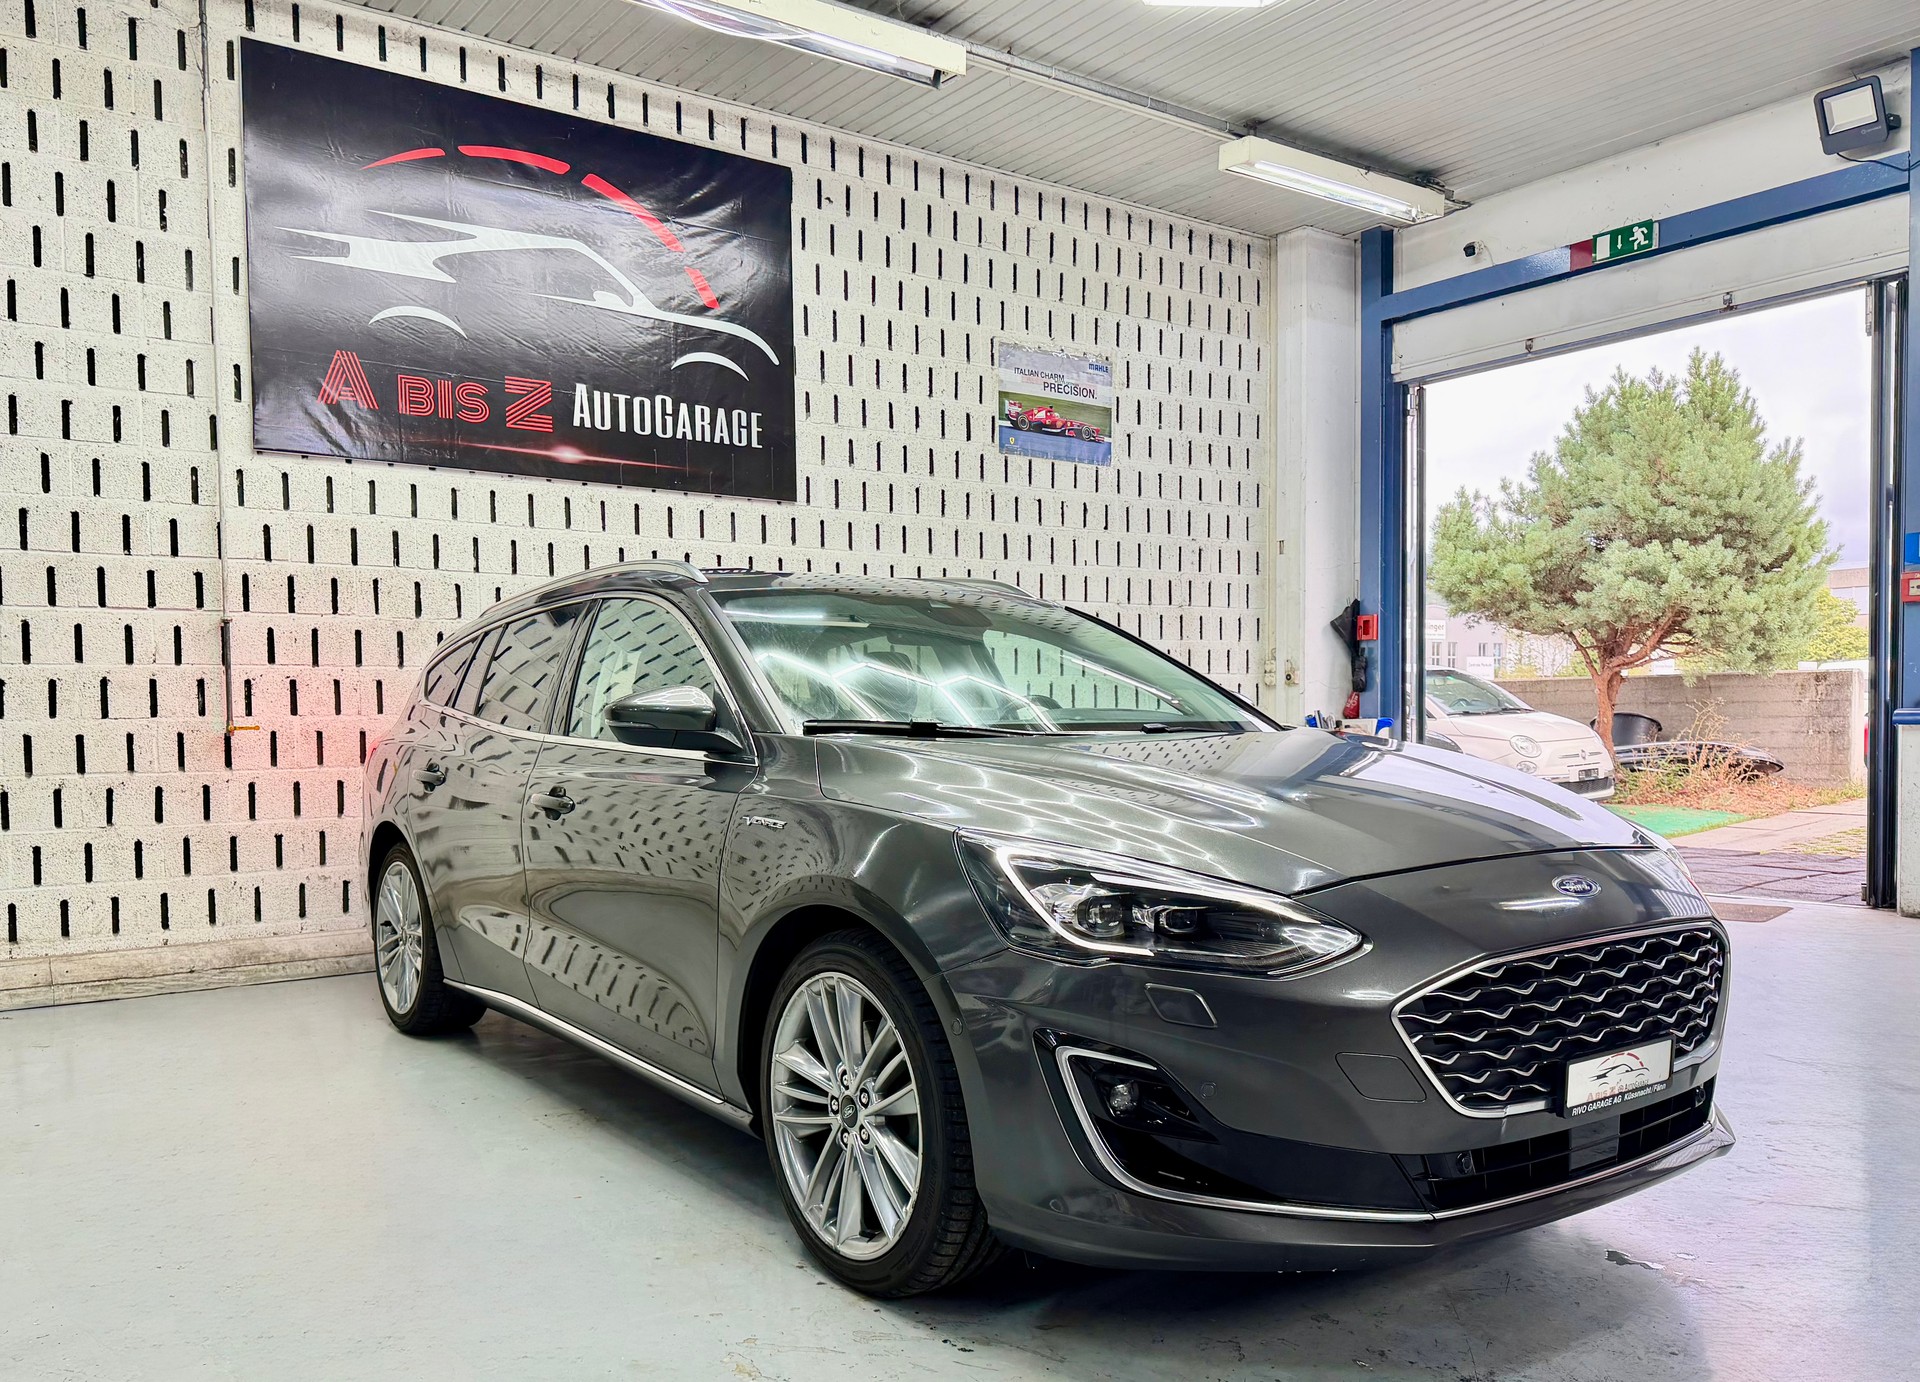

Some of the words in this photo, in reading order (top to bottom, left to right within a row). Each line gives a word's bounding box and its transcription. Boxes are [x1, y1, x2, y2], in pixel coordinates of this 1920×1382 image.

[1014, 367, 1039, 378] ITALIAN
[1088, 363, 1109, 373] MAHLE
[317, 349, 379, 410] A
[398, 374, 490, 424] BIS
[505, 375, 554, 433] Z
[573, 383, 763, 449] AUTOGARAGE
[1043, 381, 1098, 400] PRECISION.
[1587, 1096, 1613, 1112] GARAGE
[1613, 1094, 1622, 1105] AG
